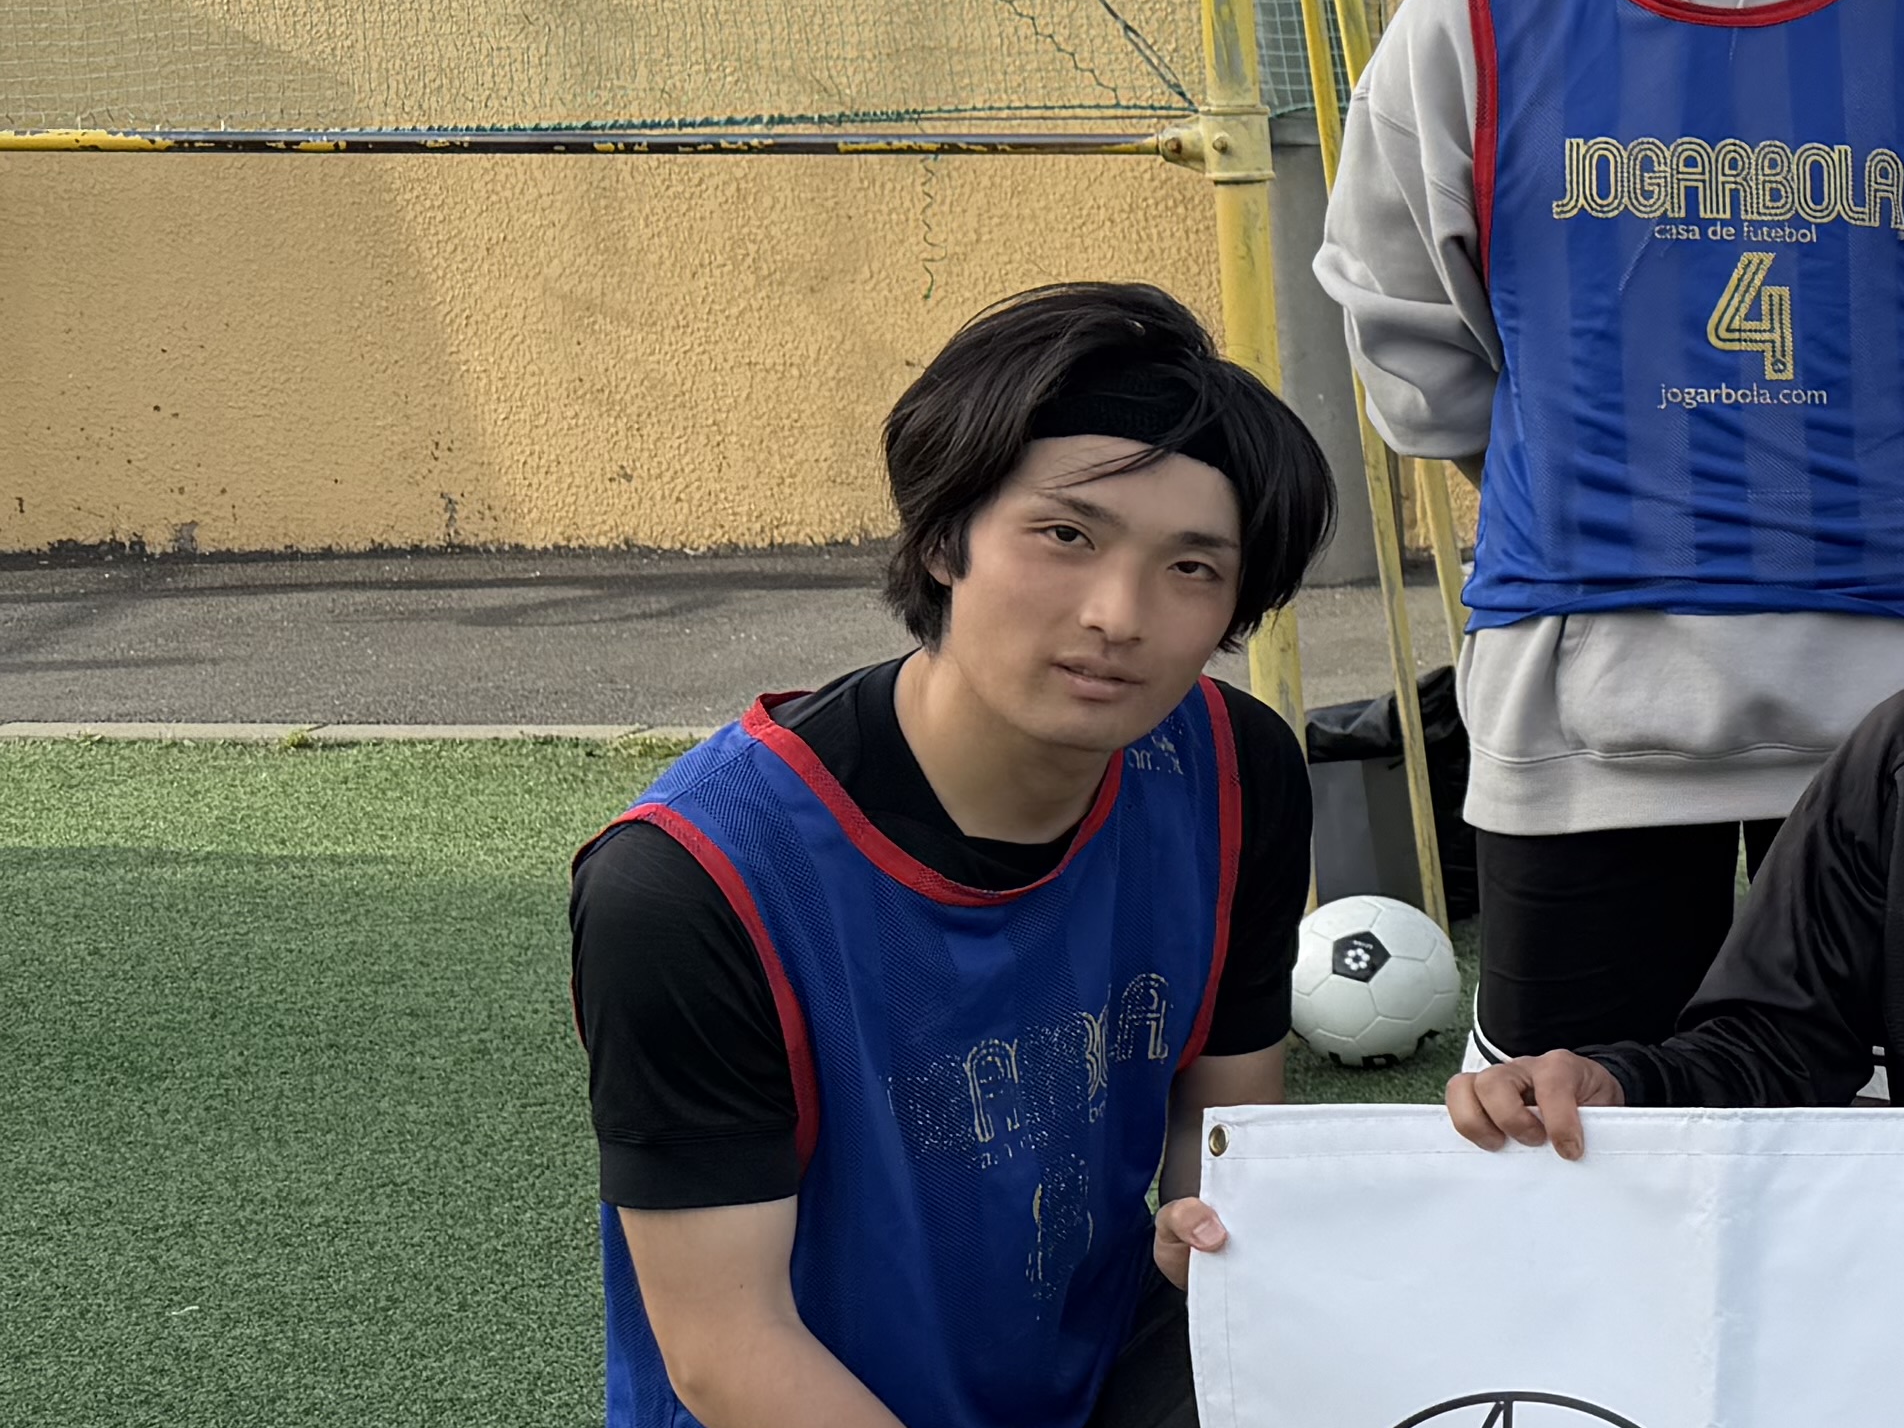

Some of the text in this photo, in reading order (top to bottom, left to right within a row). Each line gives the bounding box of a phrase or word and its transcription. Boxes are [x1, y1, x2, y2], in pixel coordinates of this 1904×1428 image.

[1654, 222, 1817, 243] casa de futebol
[1706, 251, 1794, 381] 4
[1657, 383, 1828, 409] jogarbola.com
